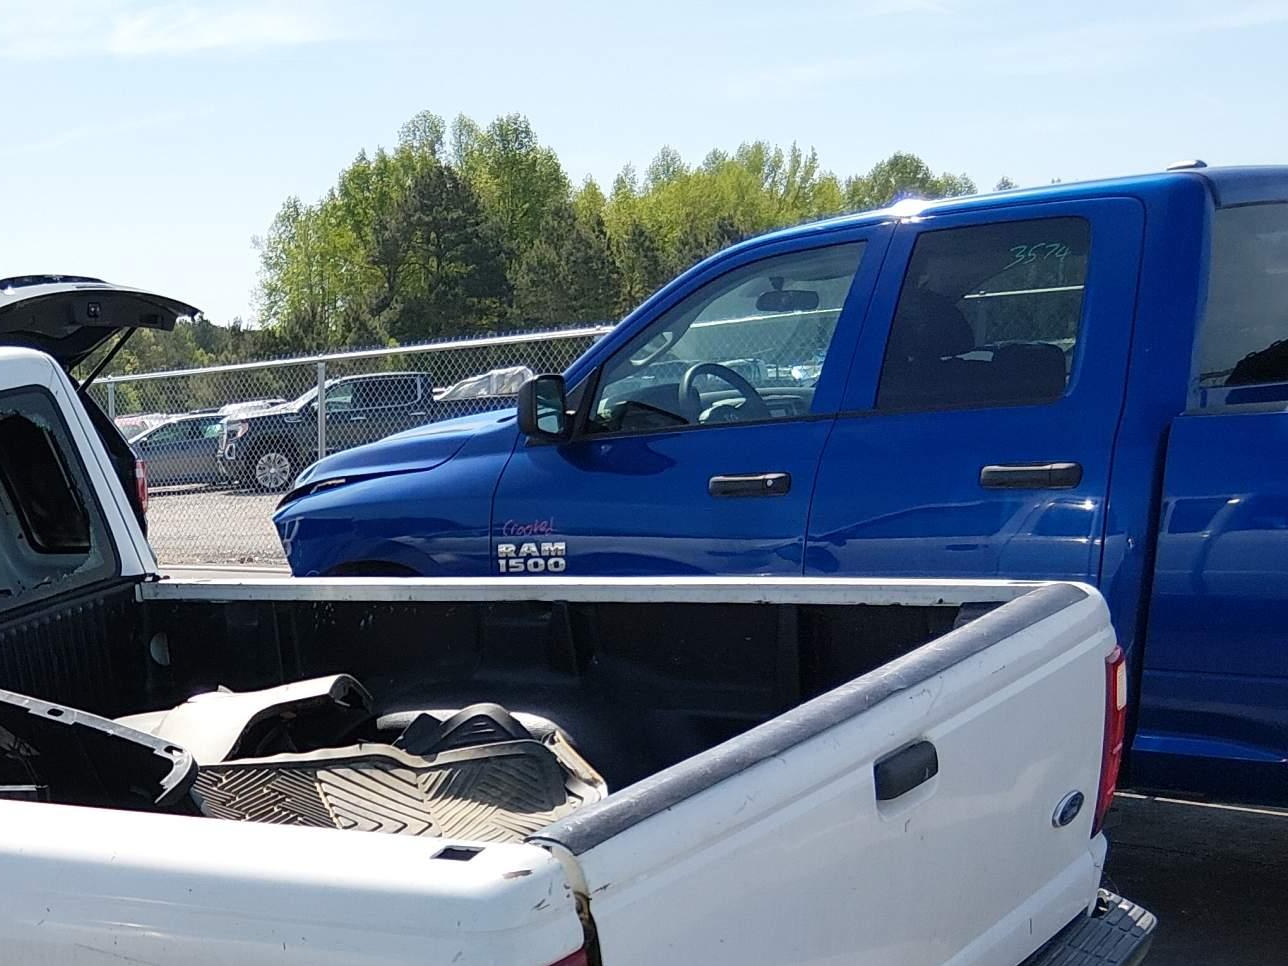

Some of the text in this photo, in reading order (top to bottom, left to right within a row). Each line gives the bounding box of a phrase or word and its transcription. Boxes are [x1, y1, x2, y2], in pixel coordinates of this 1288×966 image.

[1003, 243, 1071, 270] 3574
[498, 542, 566, 557] RAM
[498, 557, 566, 573] 1500
